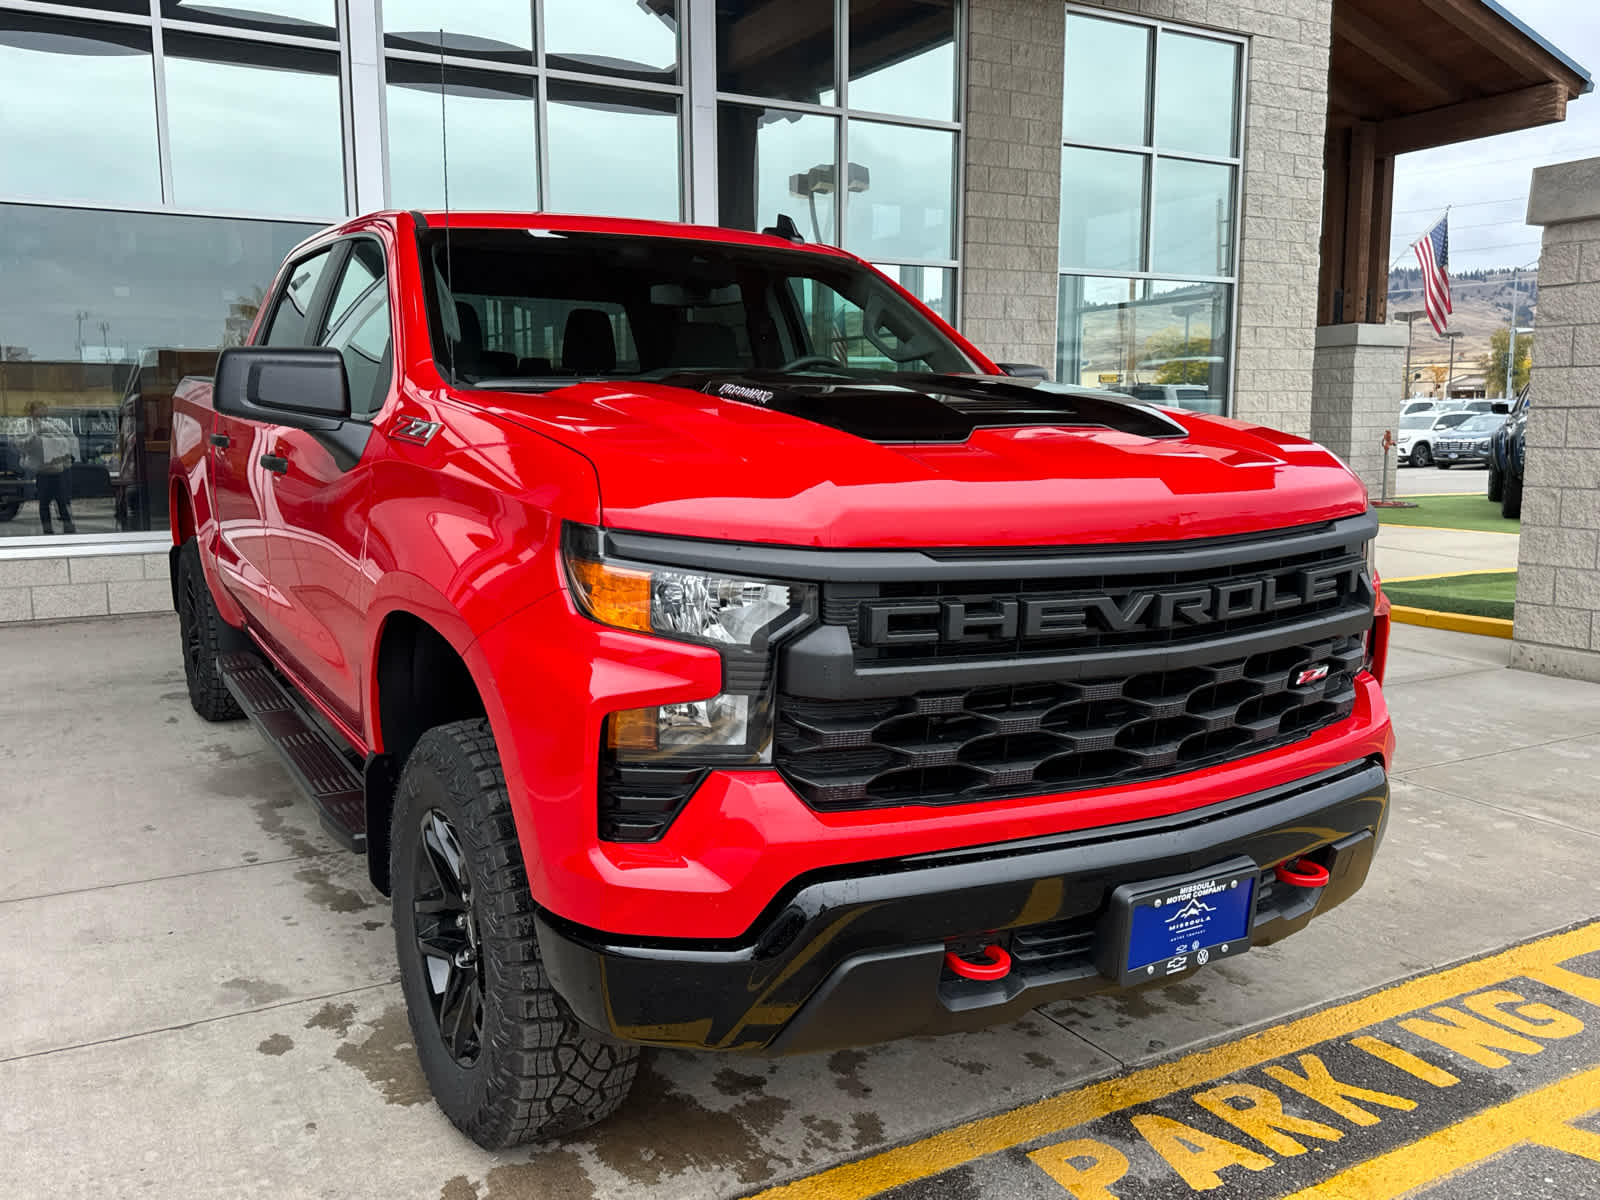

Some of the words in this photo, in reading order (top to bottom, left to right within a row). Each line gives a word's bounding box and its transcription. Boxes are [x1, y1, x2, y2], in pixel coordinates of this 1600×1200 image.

[388, 415, 443, 447] Z71
[858, 560, 1367, 648] CHEVROLET
[1166, 893, 1191, 905] MOTOR
[1193, 884, 1227, 898] COMPANY
[1180, 880, 1216, 895] MISSOULA
[1169, 915, 1211, 931] MISSOULA
[1027, 989, 1585, 1200] PARKING
